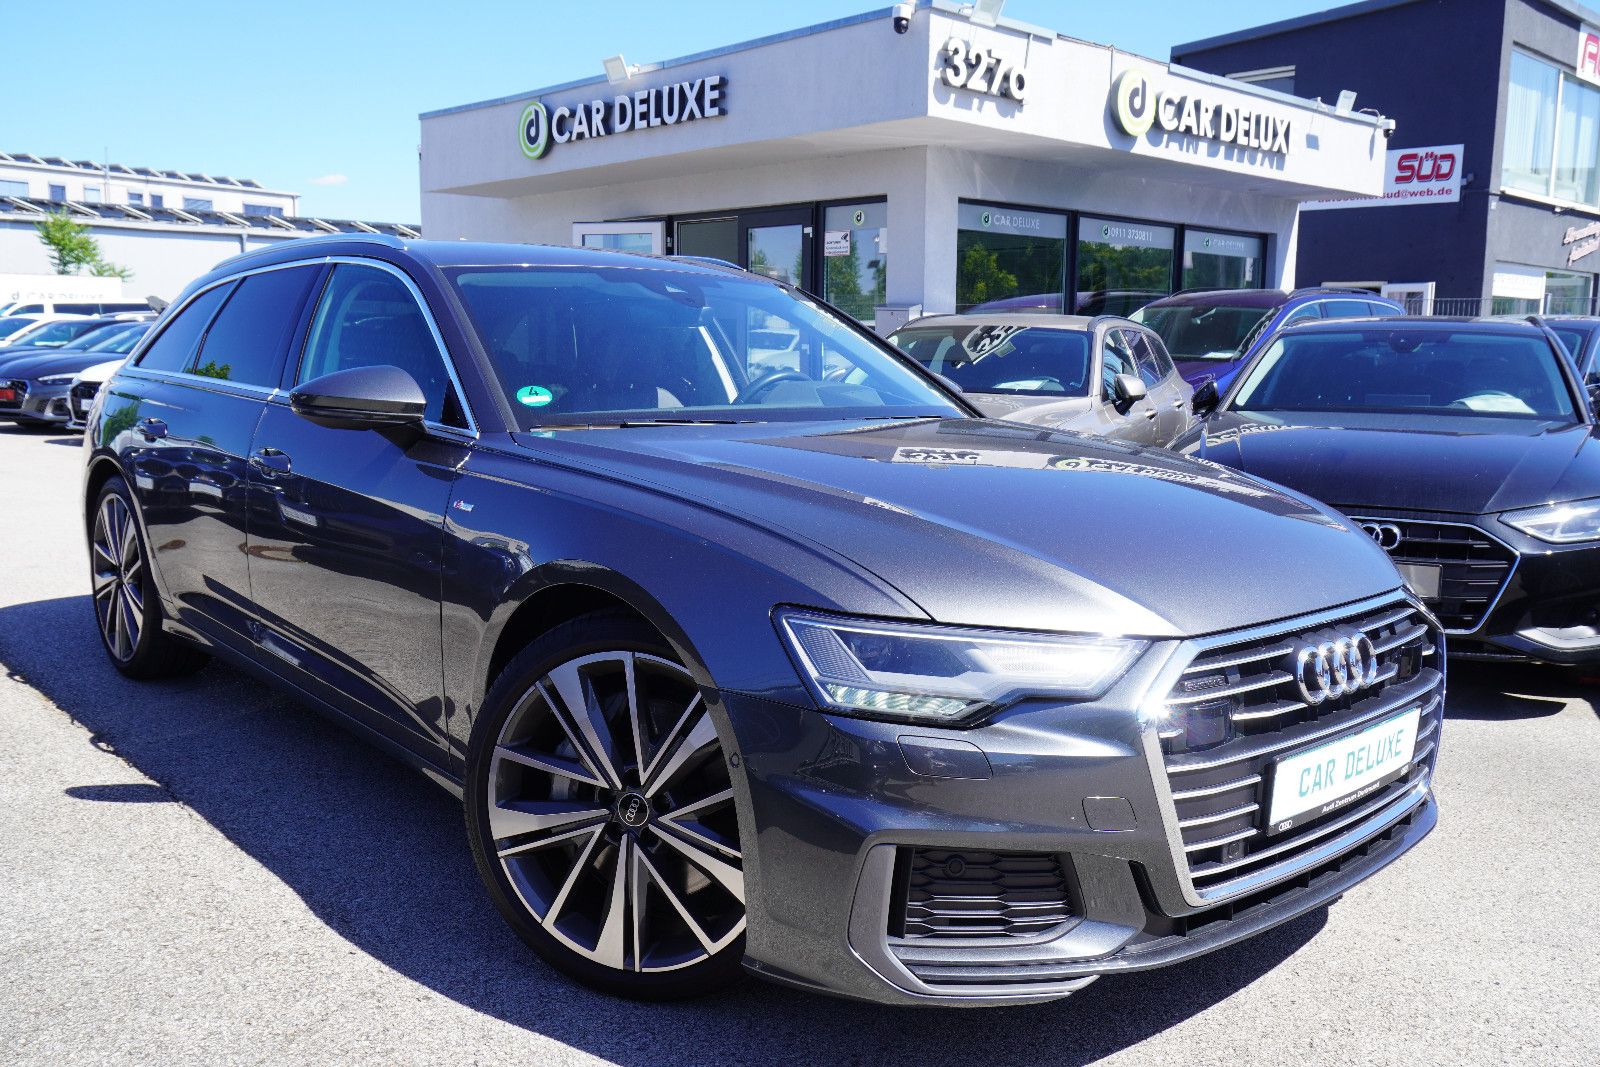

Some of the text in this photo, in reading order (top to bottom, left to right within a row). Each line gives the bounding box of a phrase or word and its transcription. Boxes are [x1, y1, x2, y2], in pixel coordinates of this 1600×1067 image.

[551, 99, 606, 144] CAR
[614, 75, 721, 134] DELUXE
[1158, 89, 1216, 138] CAR
[1394, 151, 1457, 184] SÜD
[993, 214, 1011, 227] CAR
[1012, 215, 1040, 230] DELUXE
[1298, 729, 1404, 798] CAR DELUXE
[1321, 802, 1335, 813] Audi
[1335, 793, 1357, 808] Zentrum
